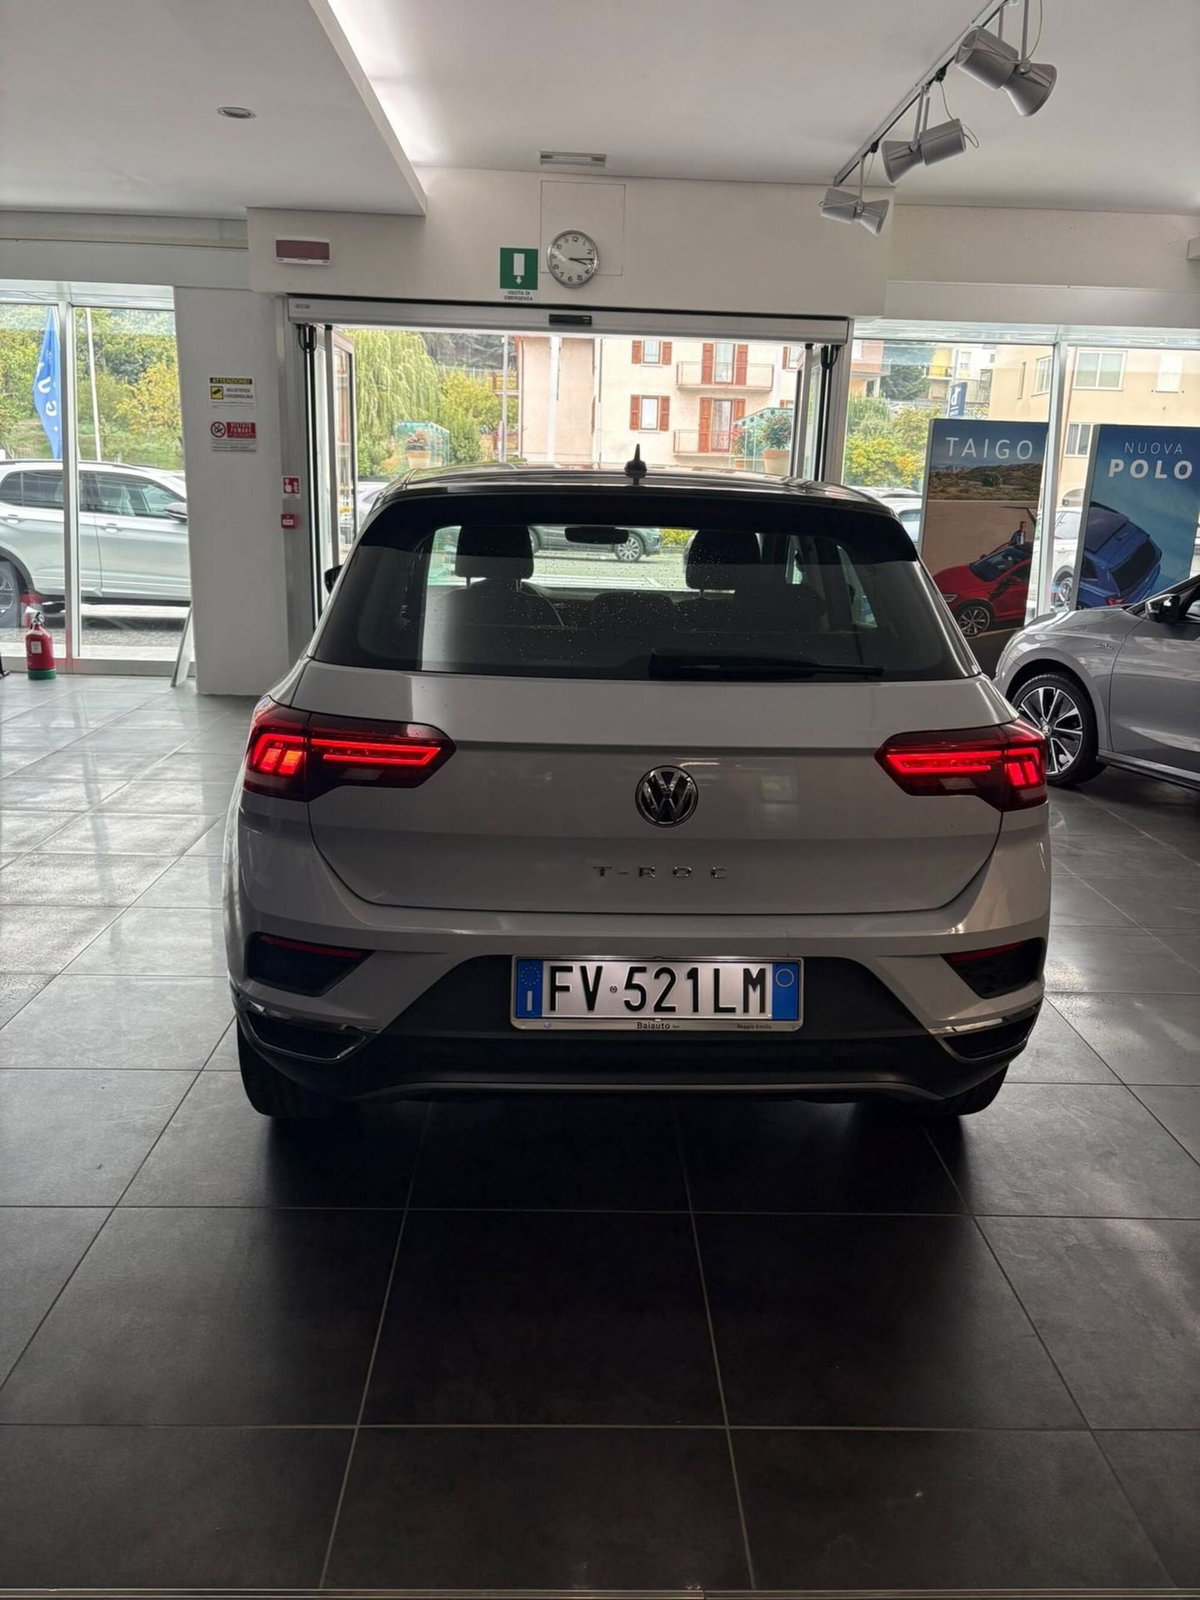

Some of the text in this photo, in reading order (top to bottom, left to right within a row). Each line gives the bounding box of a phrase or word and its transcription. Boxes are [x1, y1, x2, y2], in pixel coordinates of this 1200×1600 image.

[945, 437, 1033, 460] TAIGO
[1124, 442, 1183, 455] NUOVA
[1108, 459, 1193, 480] POLO
[594, 865, 728, 880] T-ROC
[549, 965, 766, 1014] FV 521LM
[636, 1022, 671, 1030] Baiauto
